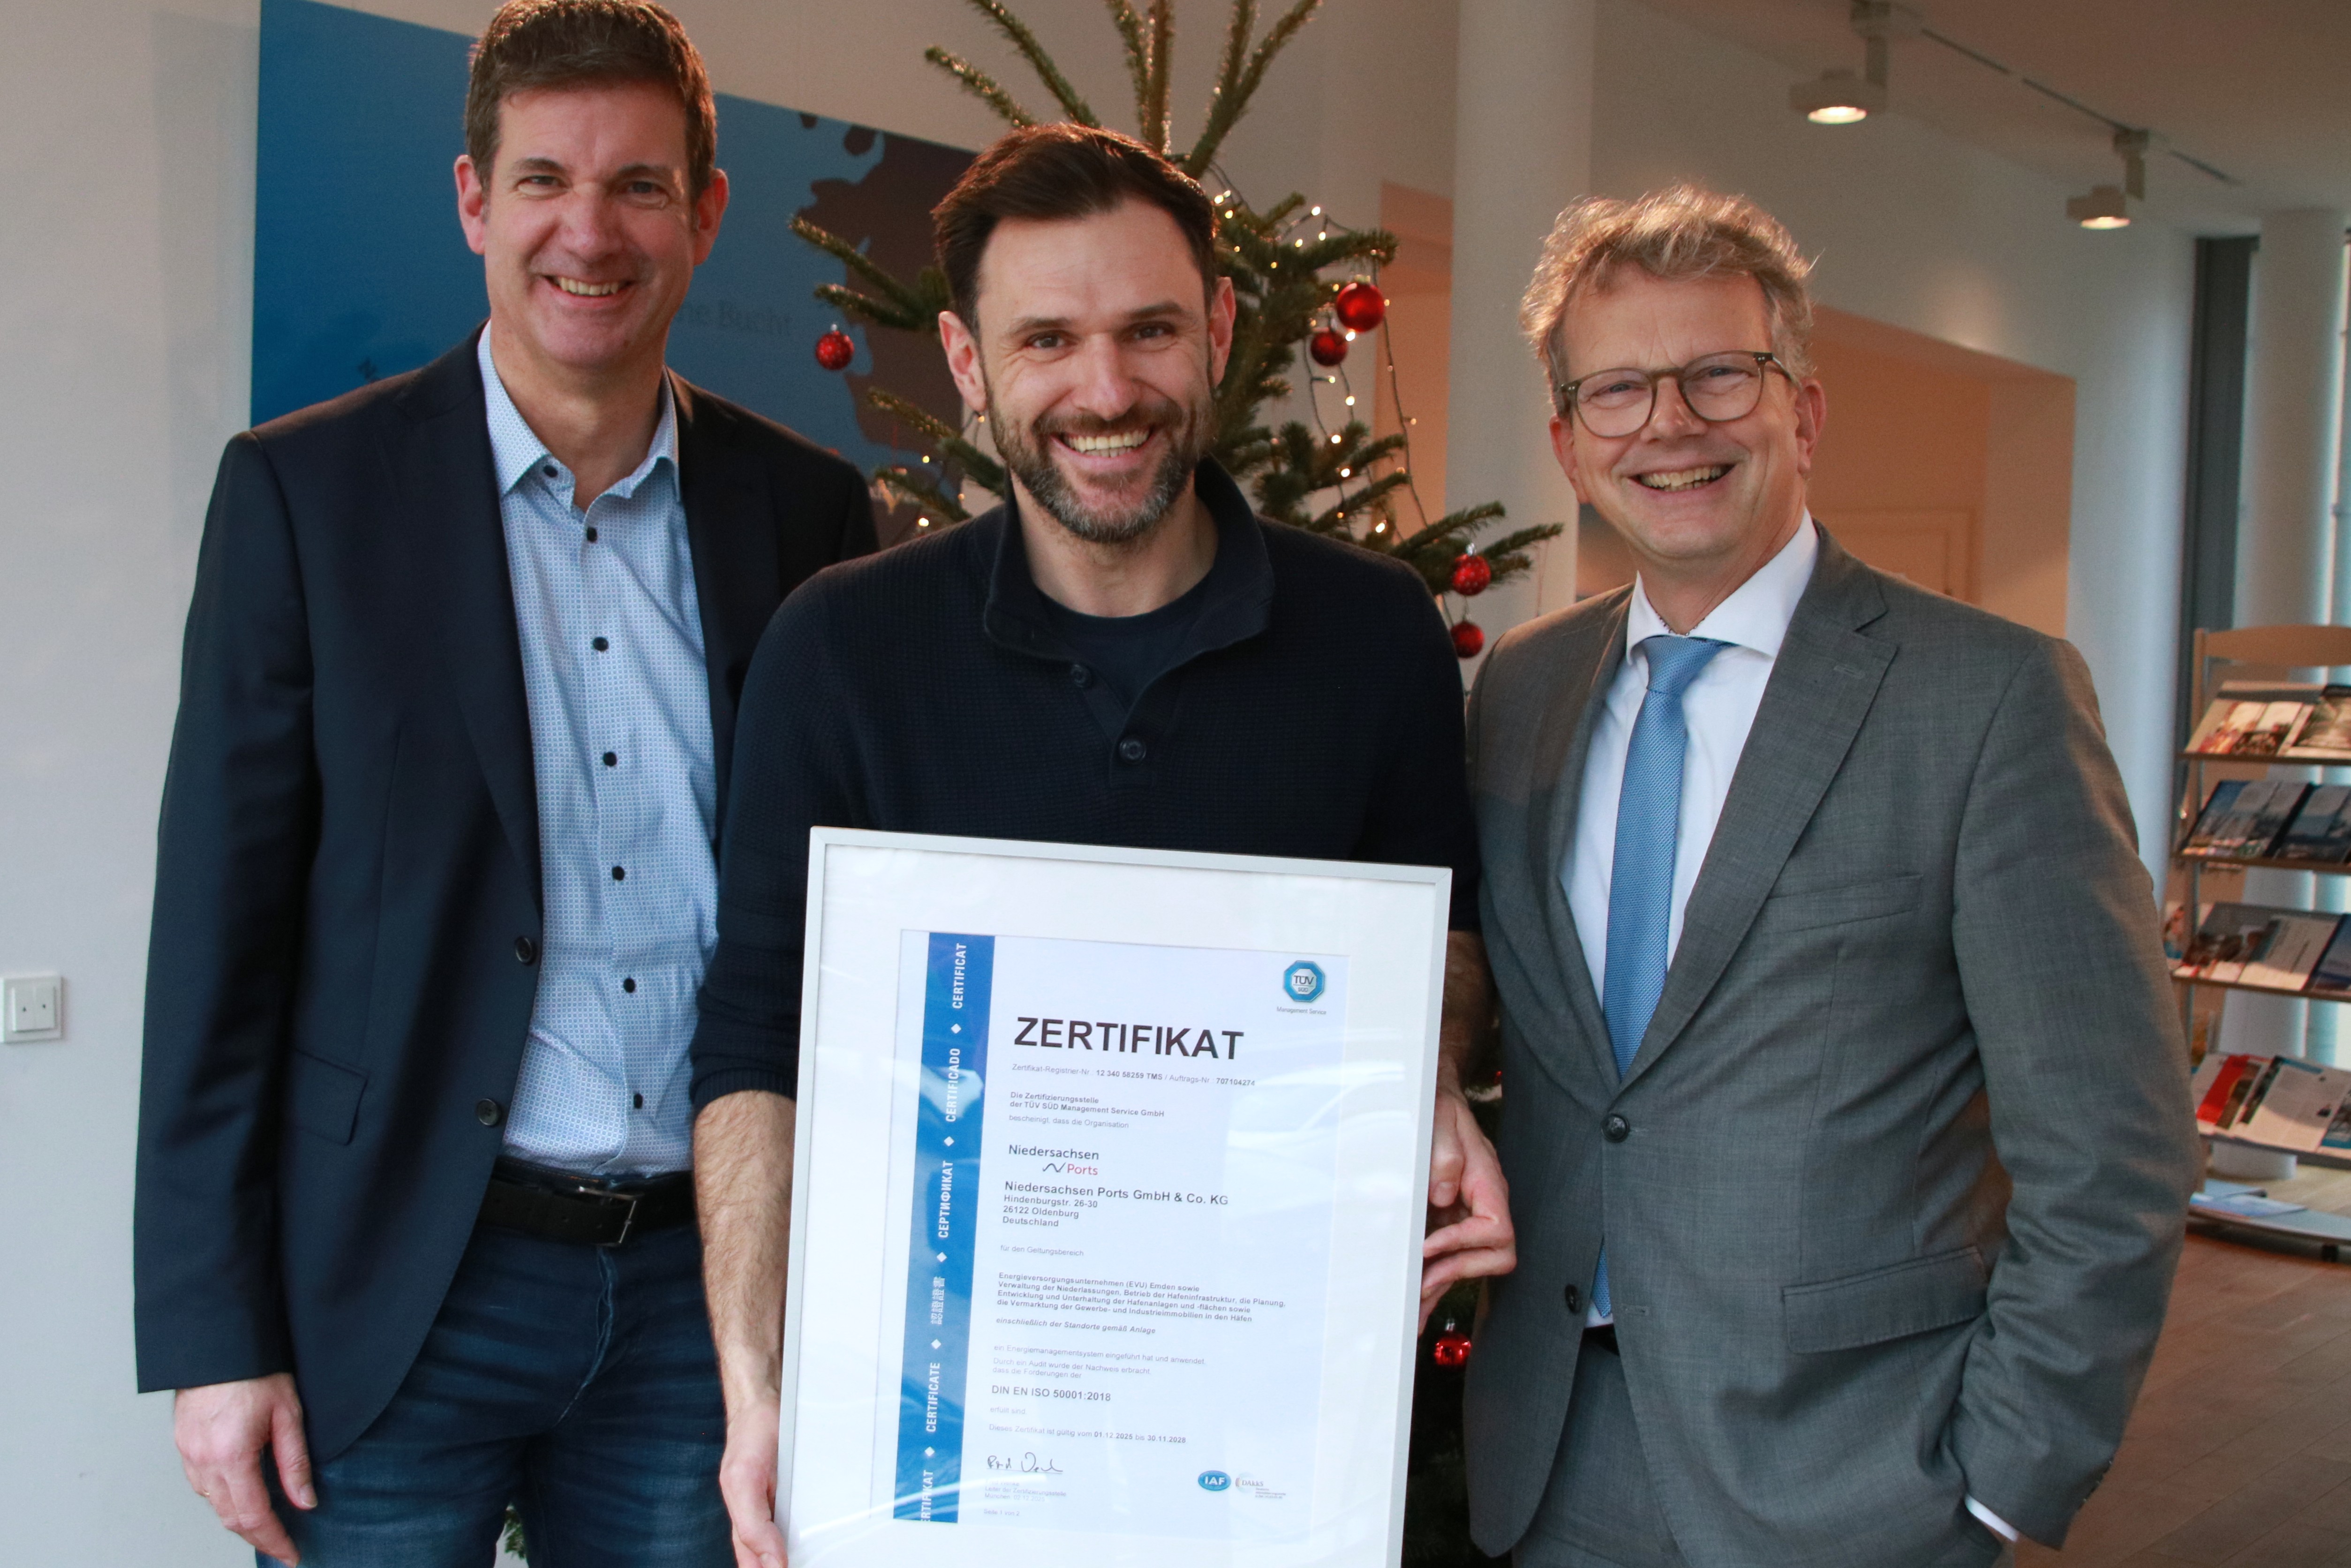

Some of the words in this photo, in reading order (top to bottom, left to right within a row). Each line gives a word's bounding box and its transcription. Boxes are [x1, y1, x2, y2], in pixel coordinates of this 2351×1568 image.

[952, 942, 967, 1010] CERTIFICAT
[1294, 975, 1314, 985] TÜV
[1014, 1017, 1244, 1060] ZERTIFIKAT
[945, 1047, 961, 1123] CERTIFICADO
[1216, 1077, 1255, 1086] 707104274
[1025, 1093, 1099, 1104] Zertifizierungsstelle
[1061, 1102, 1109, 1113] Management
[1111, 1107, 1138, 1116] Service
[1084, 1119, 1129, 1128] Organisation
[1009, 1145, 1099, 1160] Niedersachsen
[1067, 1163, 1098, 1176] Ports
[938, 1160, 954, 1239] СЕРТИФИКАТ
[1005, 1181, 1093, 1196] Niedersachsen
[1098, 1187, 1129, 1199] Ports
[1133, 1190, 1170, 1201] GmbH
[1174, 1192, 1182, 1202] &
[1187, 1193, 1206, 1204] Co.
[1210, 1195, 1228, 1205] KG
[1004, 1195, 1070, 1206] Hindenburgstr.
[1074, 1199, 1098, 1208] 26-30
[1003, 1205, 1029, 1214] 26122
[1032, 1207, 1079, 1220] Oldenburg
[1002, 1216, 1059, 1227] Deutschland
[1027, 1246, 1084, 1256] Geltungsbereich
[999, 1273, 1124, 1286] Energieversorgungsunternehmen
[1126, 1281, 1147, 1289] (EVU)
[998, 1280, 1040, 1293] Verwaltung
[1057, 1283, 1121, 1296] Niederlassungen,
[1124, 1289, 1151, 1297] Betrieb
[1168, 1293, 1237, 1303] Hafeninfrastruktur,
[1253, 1298, 1285, 1308] Planung,
[998, 1289, 1043, 1301] Entwicklung
[1062, 1295, 1110, 1305] Unterhaltung
[1127, 1299, 1178, 1309] Hafenanlagen
[1010, 1299, 1058, 1310] Vermarktung
[1075, 1304, 1110, 1312] Gewerbe-
[1129, 1308, 1203, 1319] Industrieimmobilien
[1064, 1321, 1100, 1330] Standorte
[1129, 1326, 1156, 1335] Anlage
[1007, 1345, 1104, 1357] Energiemanagementsystem
[1024, 1368, 1068, 1379] Forderungen
[1085, 1364, 1119, 1372] Nachweis
[926, 1362, 941, 1432] CERTIFICATE
[992, 1385, 1010, 1395] DIN
[1013, 1387, 1028, 1395] EN
[1032, 1388, 1050, 1397] ISO
[1053, 1389, 1111, 1401] 50001:2018
[1094, 1431, 1133, 1440] 01.12.2025
[1147, 1435, 1186, 1444] 30.11.2028
[1205, 1476, 1226, 1485] IAF
